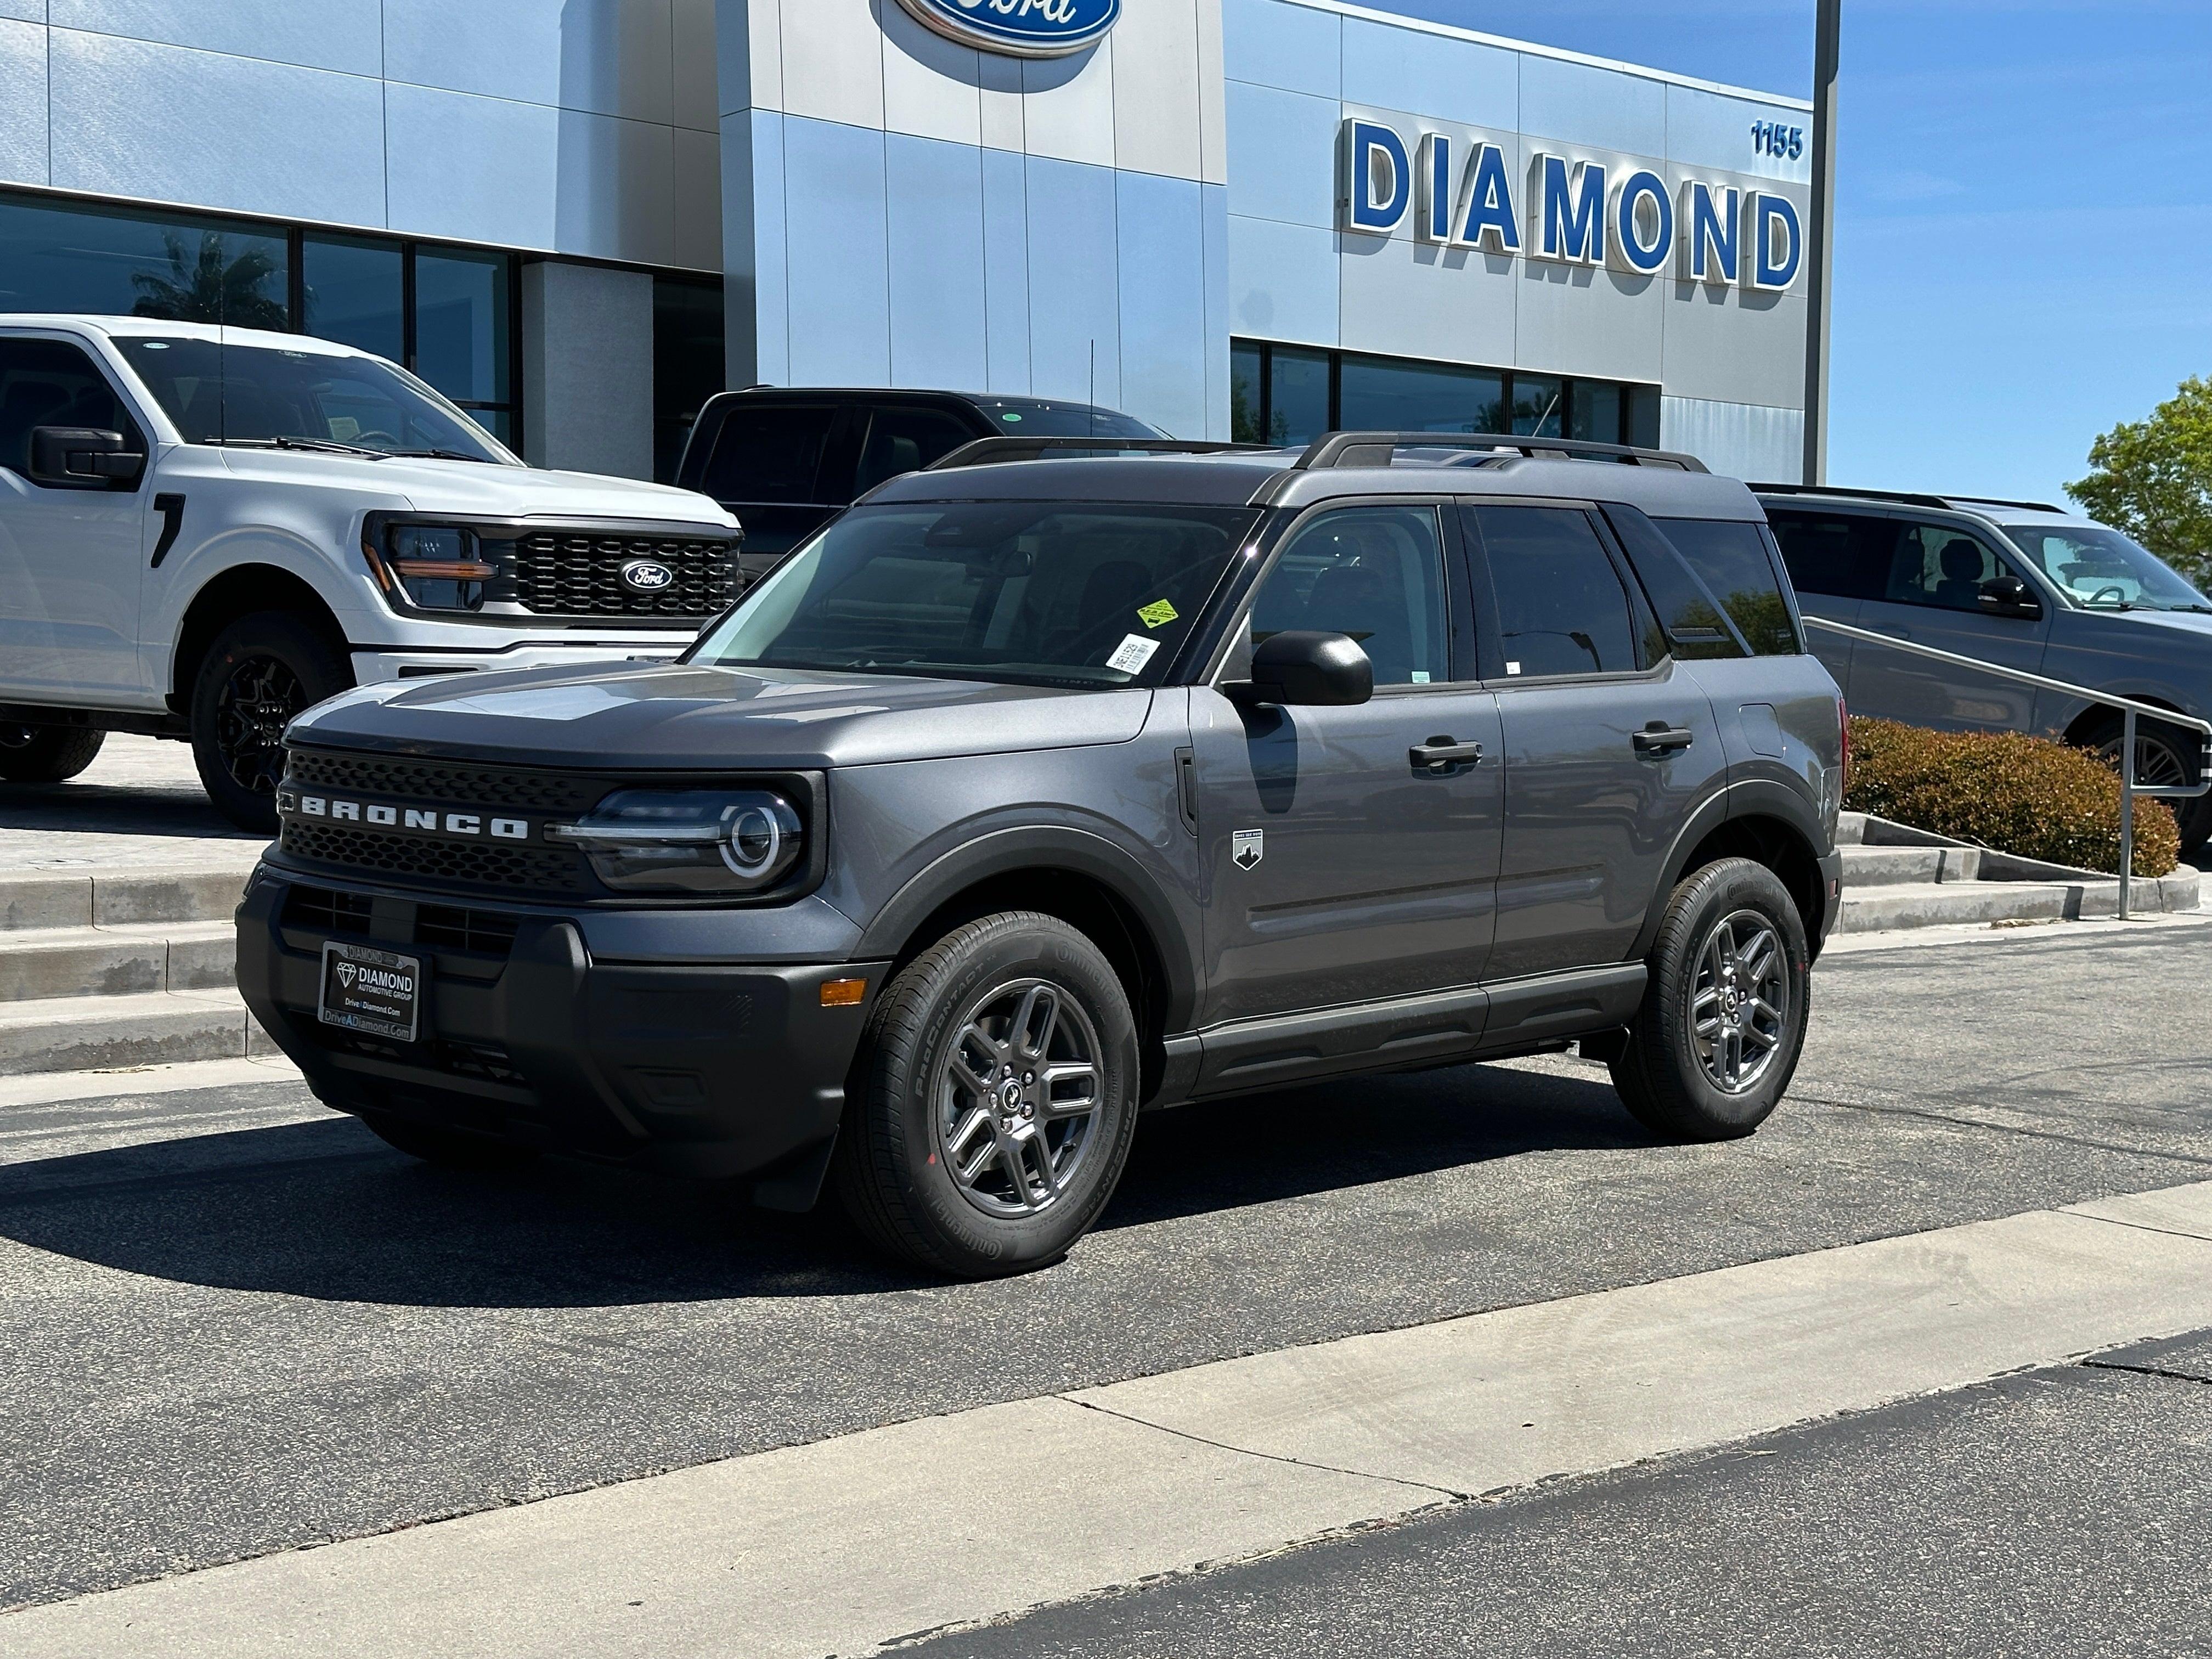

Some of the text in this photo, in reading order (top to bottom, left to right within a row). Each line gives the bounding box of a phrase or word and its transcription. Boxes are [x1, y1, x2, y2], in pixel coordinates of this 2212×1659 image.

[1751, 120, 1803, 160] 1155
[1344, 117, 1803, 292] DIAMOND
[635, 566, 664, 584] Ford
[302, 795, 528, 839] BRONCO
[349, 946, 382, 963] DIAMOND
[358, 967, 412, 992] DIAMOND
[358, 984, 413, 1001] AUTOMOTIVE GROUP
[325, 1011, 409, 1039] DriveADiamond.Com
